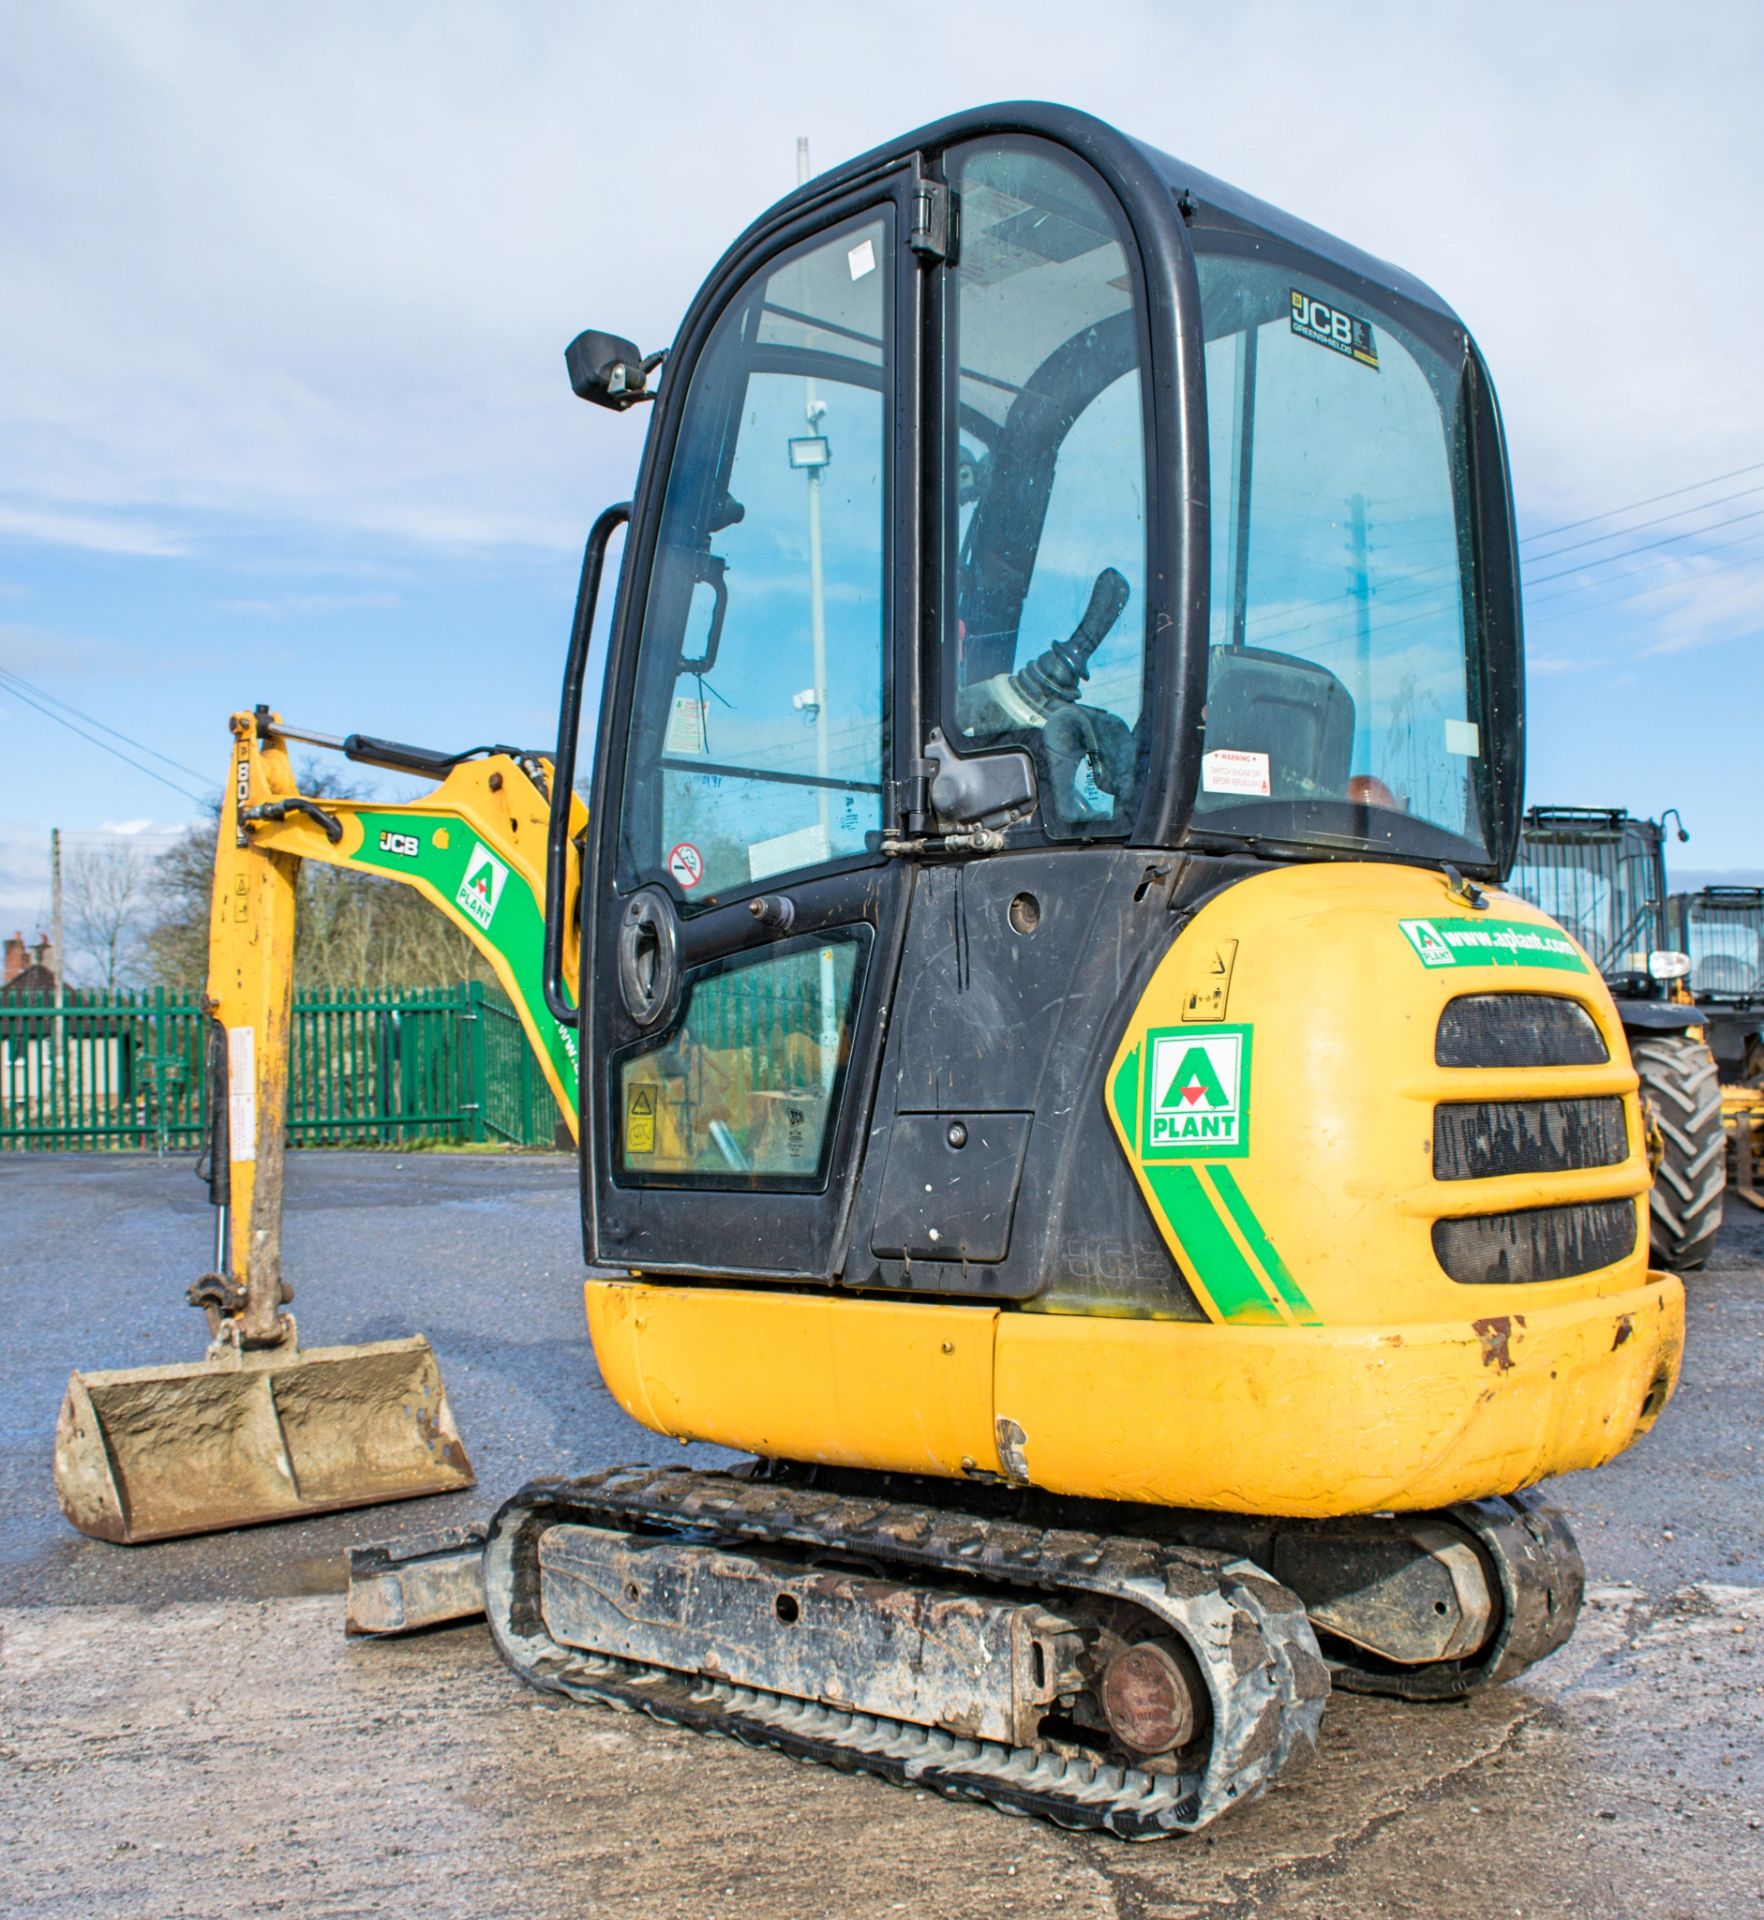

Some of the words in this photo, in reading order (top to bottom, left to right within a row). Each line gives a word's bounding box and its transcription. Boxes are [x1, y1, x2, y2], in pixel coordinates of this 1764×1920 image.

[1292, 296, 1352, 345] JCB
[1293, 322, 1352, 355] GREENSHIELDS
[1221, 753, 1251, 763] WARNING
[380, 832, 419, 856] JCB
[467, 861, 494, 905] A
[460, 887, 492, 922] PLANT
[1415, 925, 1443, 948] A
[1441, 928, 1578, 956] www.aplant.com
[1421, 951, 1453, 961] PLANT
[1160, 1047, 1230, 1108] A
[1153, 1115, 1236, 1139] PLANT
